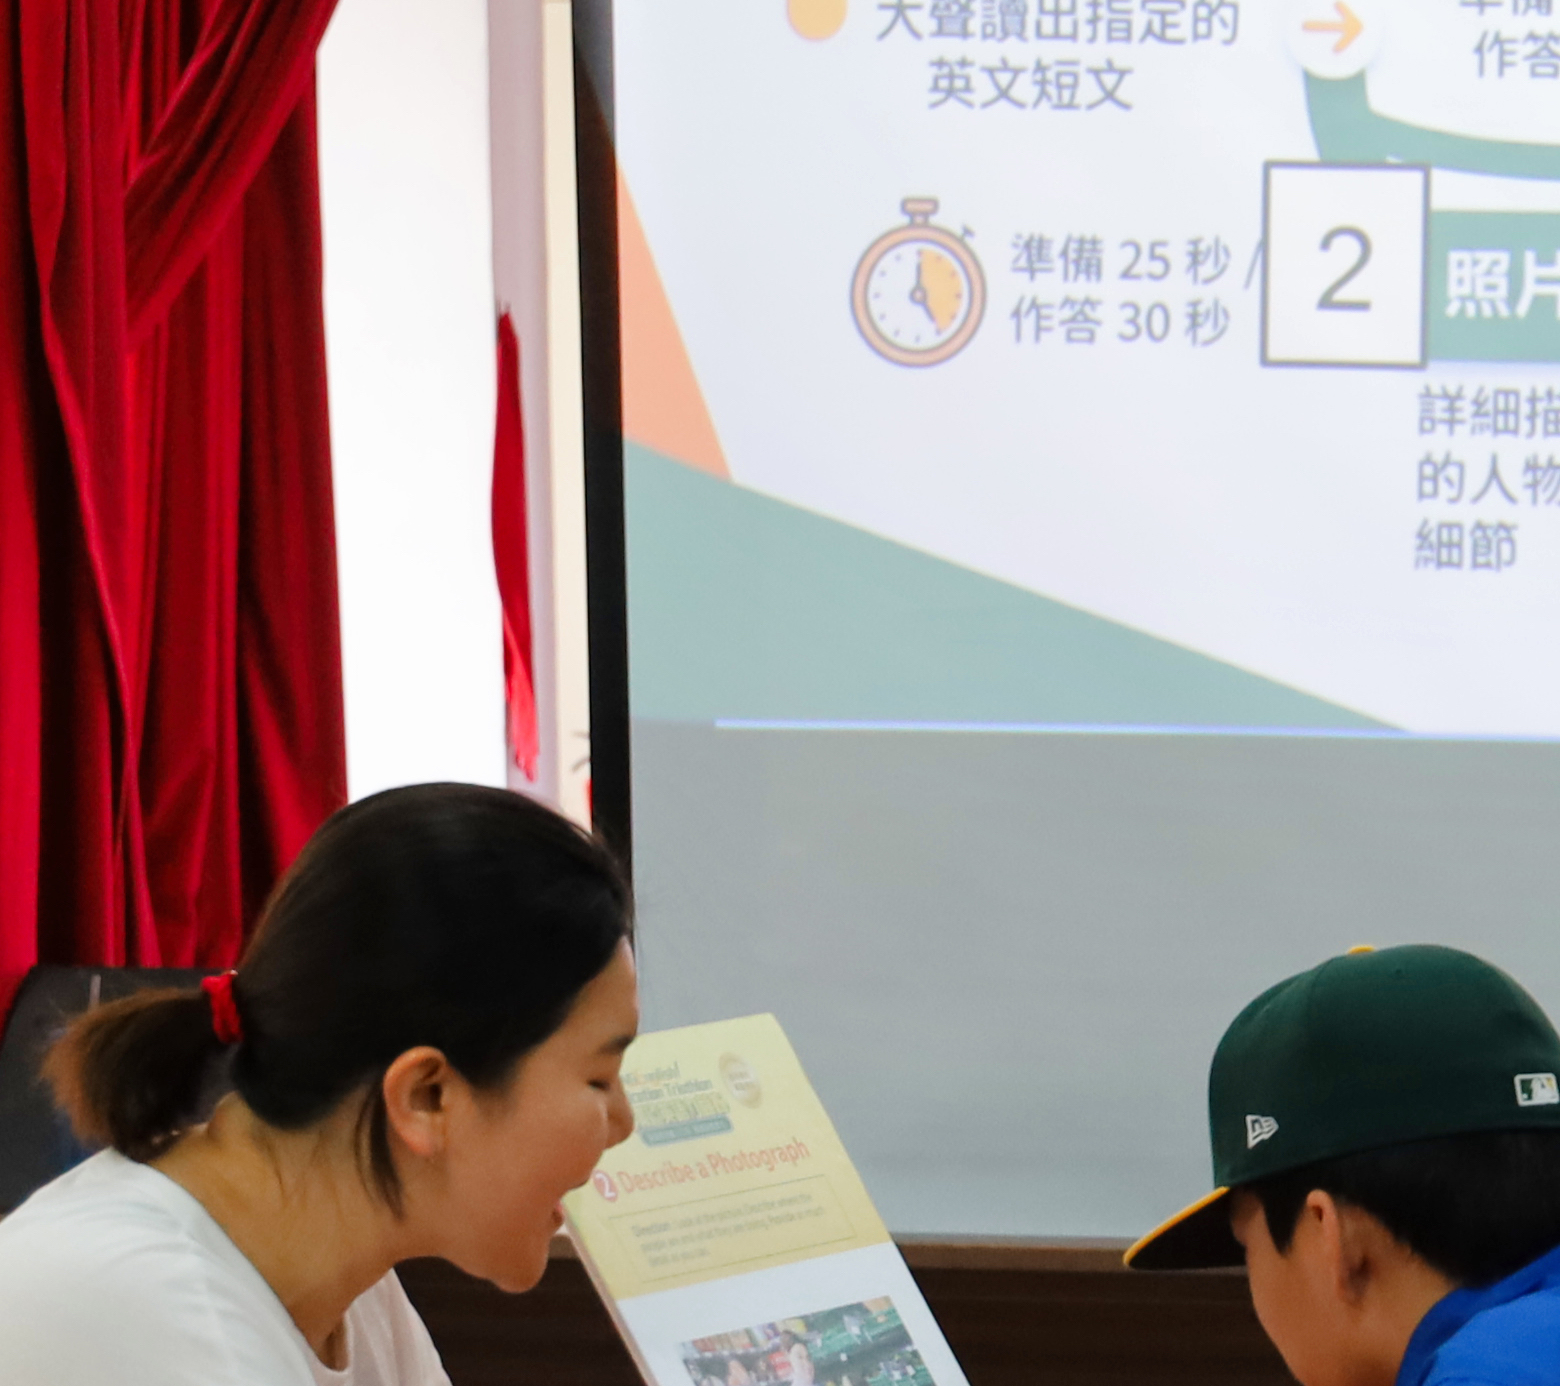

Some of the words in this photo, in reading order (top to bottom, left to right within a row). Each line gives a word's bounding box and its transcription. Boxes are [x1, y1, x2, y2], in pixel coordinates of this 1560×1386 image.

[928, 56, 1133, 112] 英文短文
[1118, 239, 1172, 282] 25
[1316, 224, 1373, 312] 2
[1117, 301, 1172, 344] 30
[1414, 518, 1517, 572] 細節
[595, 1171, 616, 1199] 2
[617, 1160, 697, 1193] Describe
[698, 1162, 710, 1178] a
[706, 1139, 811, 1176] Photograph
